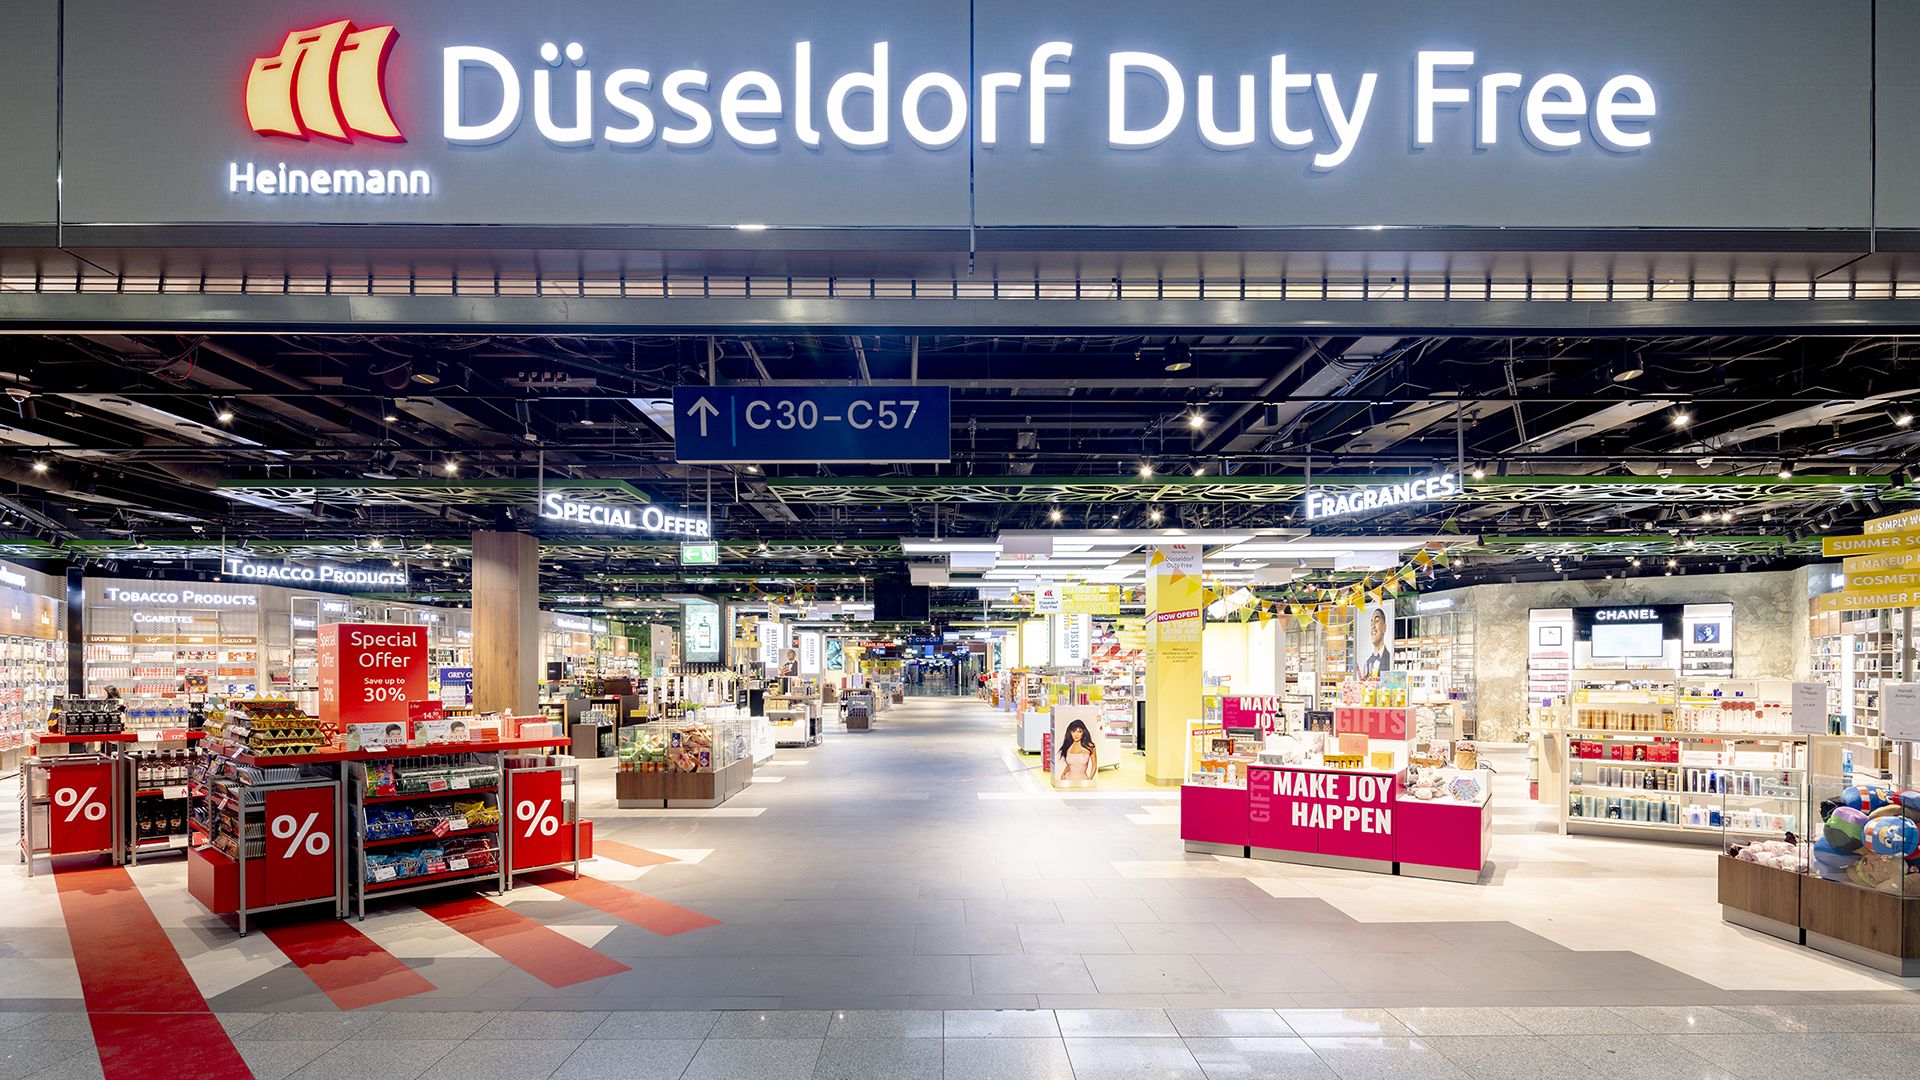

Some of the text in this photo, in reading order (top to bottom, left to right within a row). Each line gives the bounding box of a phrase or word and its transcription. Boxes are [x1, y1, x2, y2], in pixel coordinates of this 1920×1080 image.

[442, 41, 1657, 172] Düsseldorf Duty Free
[228, 161, 431, 196] Heinemann
[1307, 473, 1456, 520] FRAGRANCES
[544, 493, 709, 538] SPECIAL OFFER
[1877, 517, 1908, 532] SIMPLY
[1833, 537, 1900, 551] SUMMER
[1862, 554, 1913, 569] MAKEUP
[226, 558, 407, 586] TOBACCO PRODUCTS
[107, 588, 257, 605] TOBACCO PRODUCTS
[1844, 592, 1908, 606] SUMMER
[132, 612, 194, 624] CIGARETTES
[1158, 612, 1176, 621] NOW
[1176, 610, 1198, 620] OPEN!
[1595, 608, 1659, 621] CHANEL
[351, 631, 418, 650] Special
[359, 651, 411, 668] Offer
[364, 677, 383, 685] Save
[385, 678, 395, 686] up
[447, 671, 465, 679] GREY
[363, 687, 406, 702] 30%
[1240, 697, 1280, 711] MAKE
[1336, 708, 1406, 735] GIFTS
[1249, 768, 1271, 823] GIFTS
[1273, 770, 1393, 804] MAKE JOY
[54, 786, 107, 823] %
[516, 799, 560, 838] %
[1291, 801, 1392, 836] HAPPEN
[271, 812, 331, 859] %
